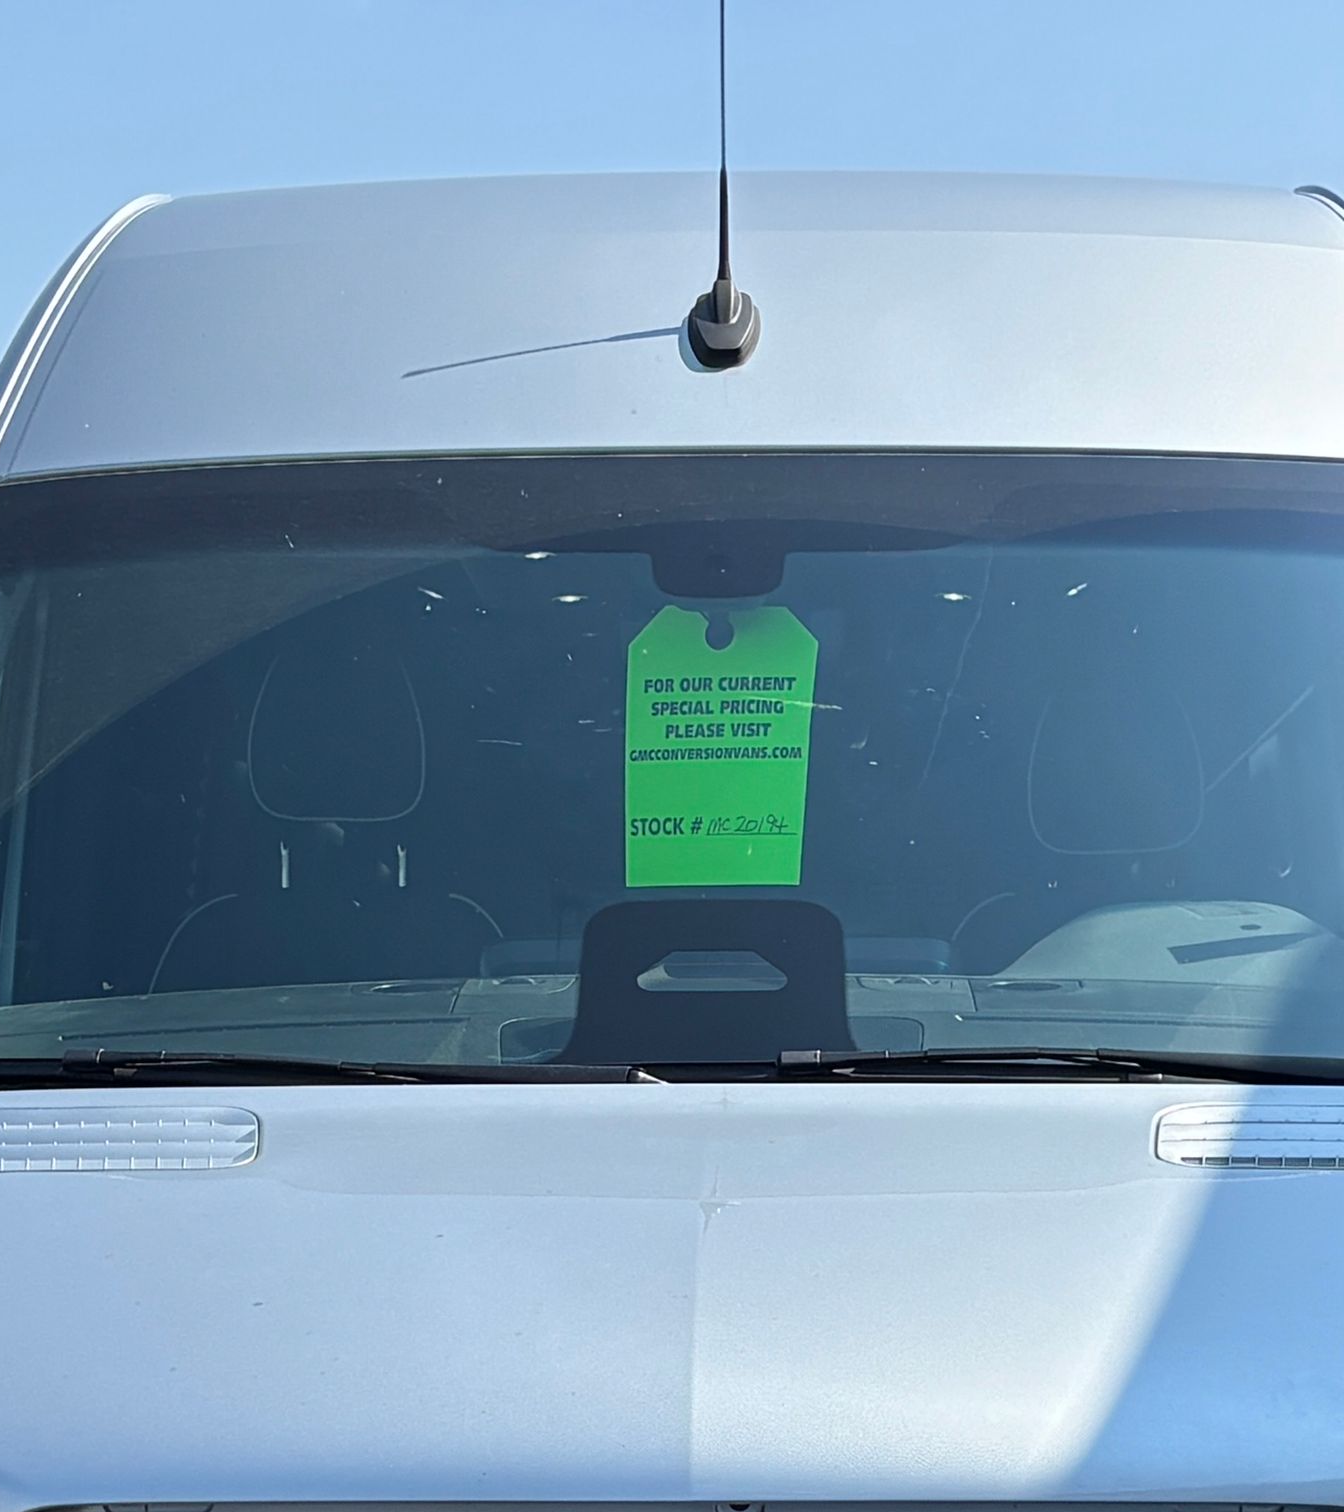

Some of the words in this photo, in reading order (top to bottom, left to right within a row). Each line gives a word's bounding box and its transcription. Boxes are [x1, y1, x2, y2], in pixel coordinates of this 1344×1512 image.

[643, 678, 675, 694] FOR
[679, 677, 714, 693] OUR
[718, 676, 797, 692] CURRENT
[650, 700, 714, 717] SPECIAL
[719, 699, 785, 715] PRICING
[665, 723, 726, 739] PLEASE
[731, 722, 772, 738] VISIT
[629, 746, 803, 762] GMCCONVERSIONVANS.COM
[630, 816, 685, 837] STOCK
[690, 816, 704, 835] #
